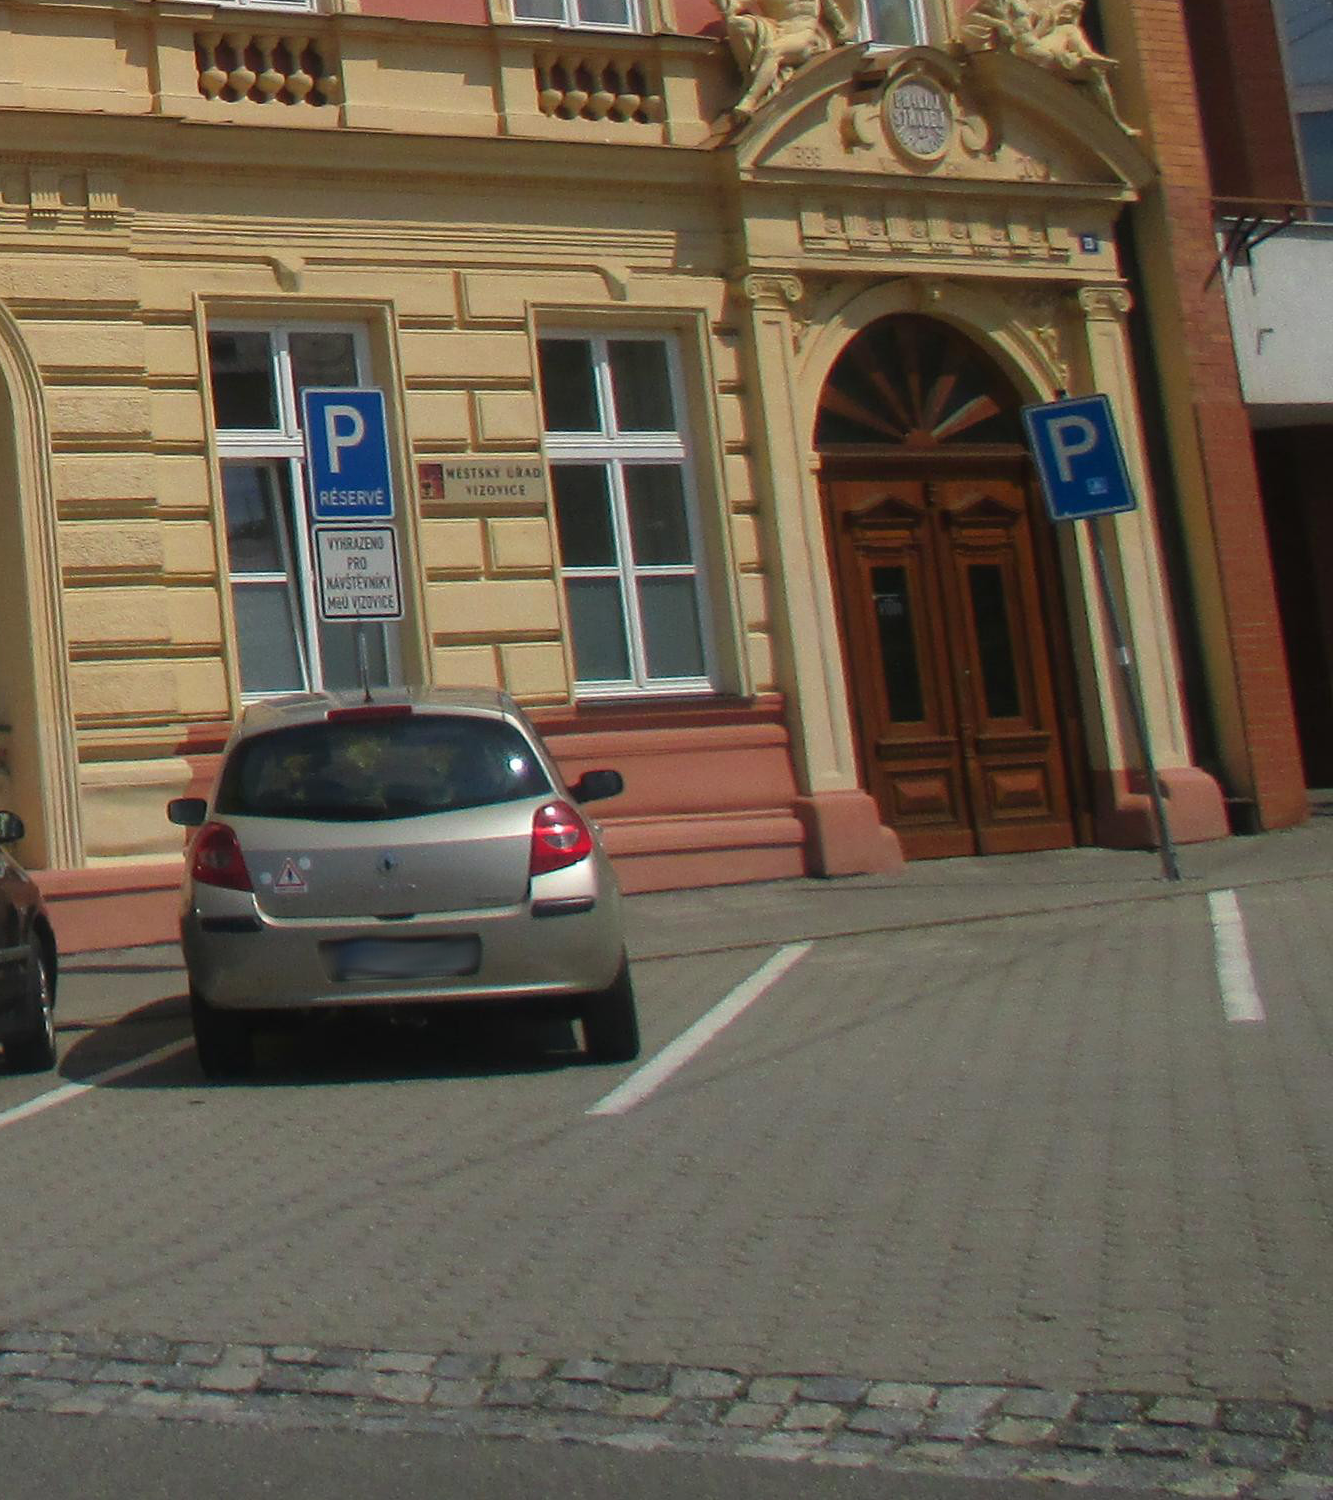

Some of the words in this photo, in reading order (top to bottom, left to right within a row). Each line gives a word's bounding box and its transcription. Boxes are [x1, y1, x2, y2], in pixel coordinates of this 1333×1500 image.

[323, 404, 365, 474] P
[1046, 415, 1098, 483] P
[465, 484, 526, 497] VIZOVICE
[327, 536, 385, 551] VYHRAZENO
[346, 556, 368, 571] PRO
[351, 594, 395, 610] VIZOVICE
